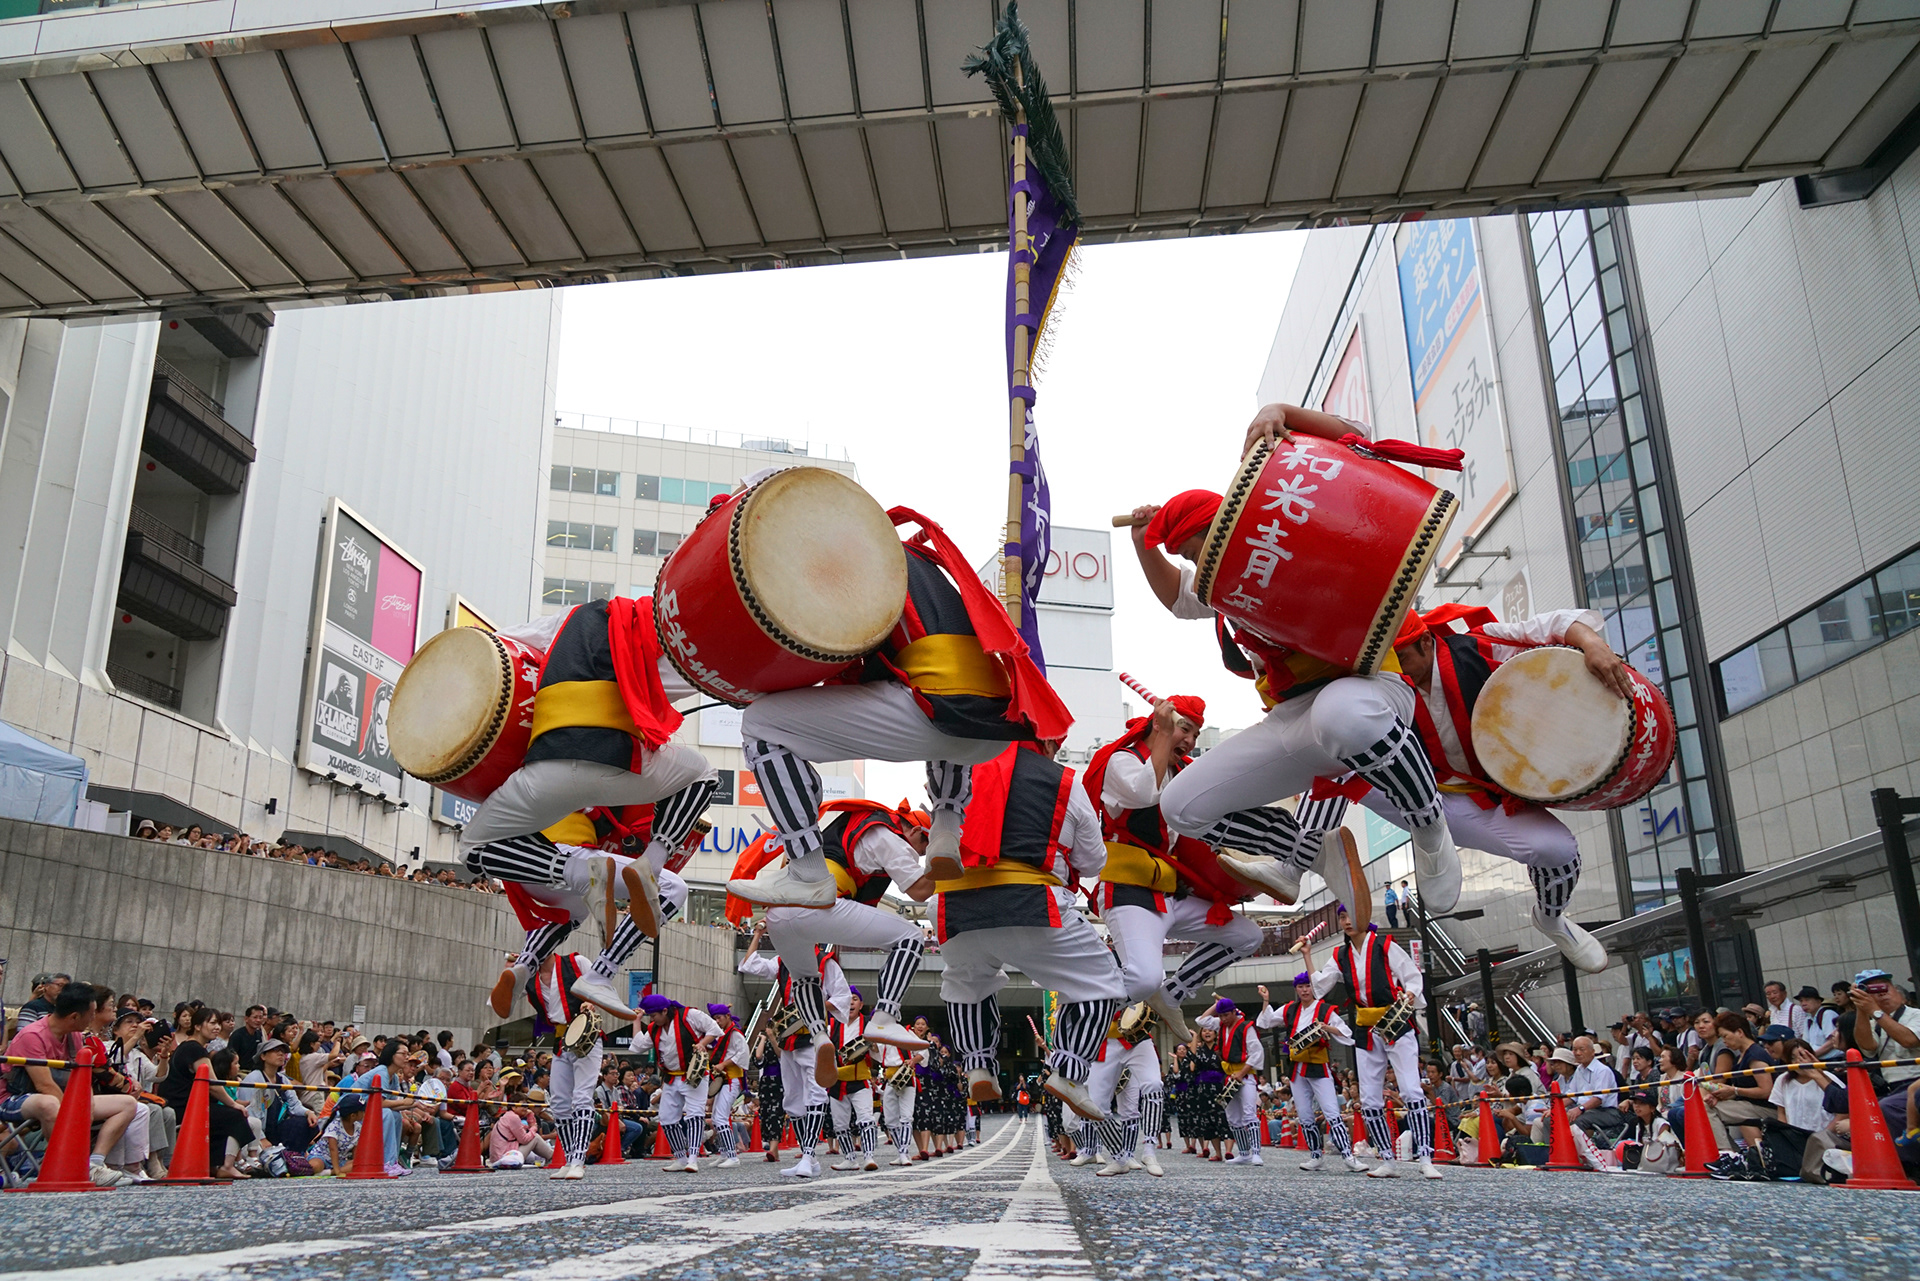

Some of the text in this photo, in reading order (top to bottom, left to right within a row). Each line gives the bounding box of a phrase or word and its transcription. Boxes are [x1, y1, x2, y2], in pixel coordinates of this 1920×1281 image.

[1416, 237, 1465, 348] イーオン
[1446, 376, 1494, 449] コンタクト
[1452, 356, 1479, 418] エース
[1456, 459, 1477, 512] 7F
[1222, 444, 1345, 632] 和光青年
[352, 644, 385, 671] EAST 3F
[318, 704, 357, 739] X-LARGE
[454, 799, 477, 822] EAST
